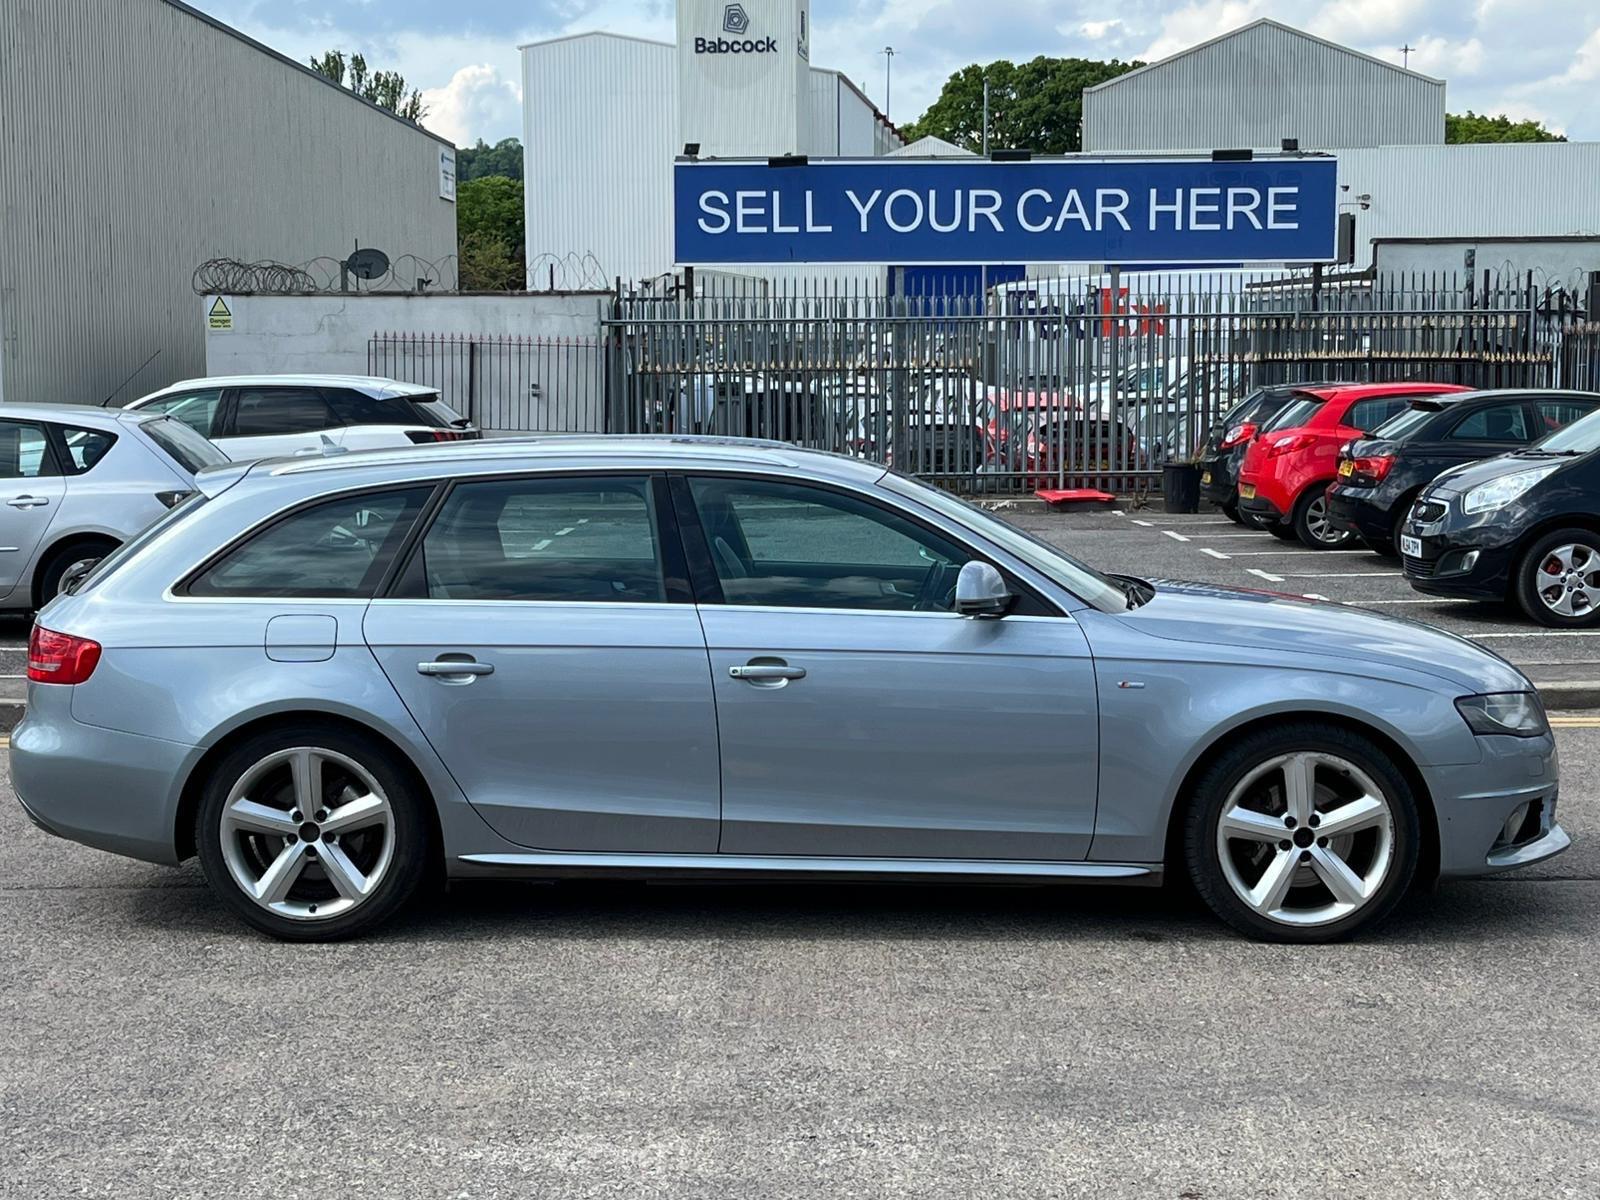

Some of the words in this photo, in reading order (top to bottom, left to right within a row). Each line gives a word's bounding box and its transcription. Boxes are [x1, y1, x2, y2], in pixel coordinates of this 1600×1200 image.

[694, 36, 777, 54] Babcock
[697, 190, 833, 234] SELL
[845, 189, 1005, 233] YOUR
[1016, 188, 1132, 232] CAR
[1149, 187, 1299, 231] HERE
